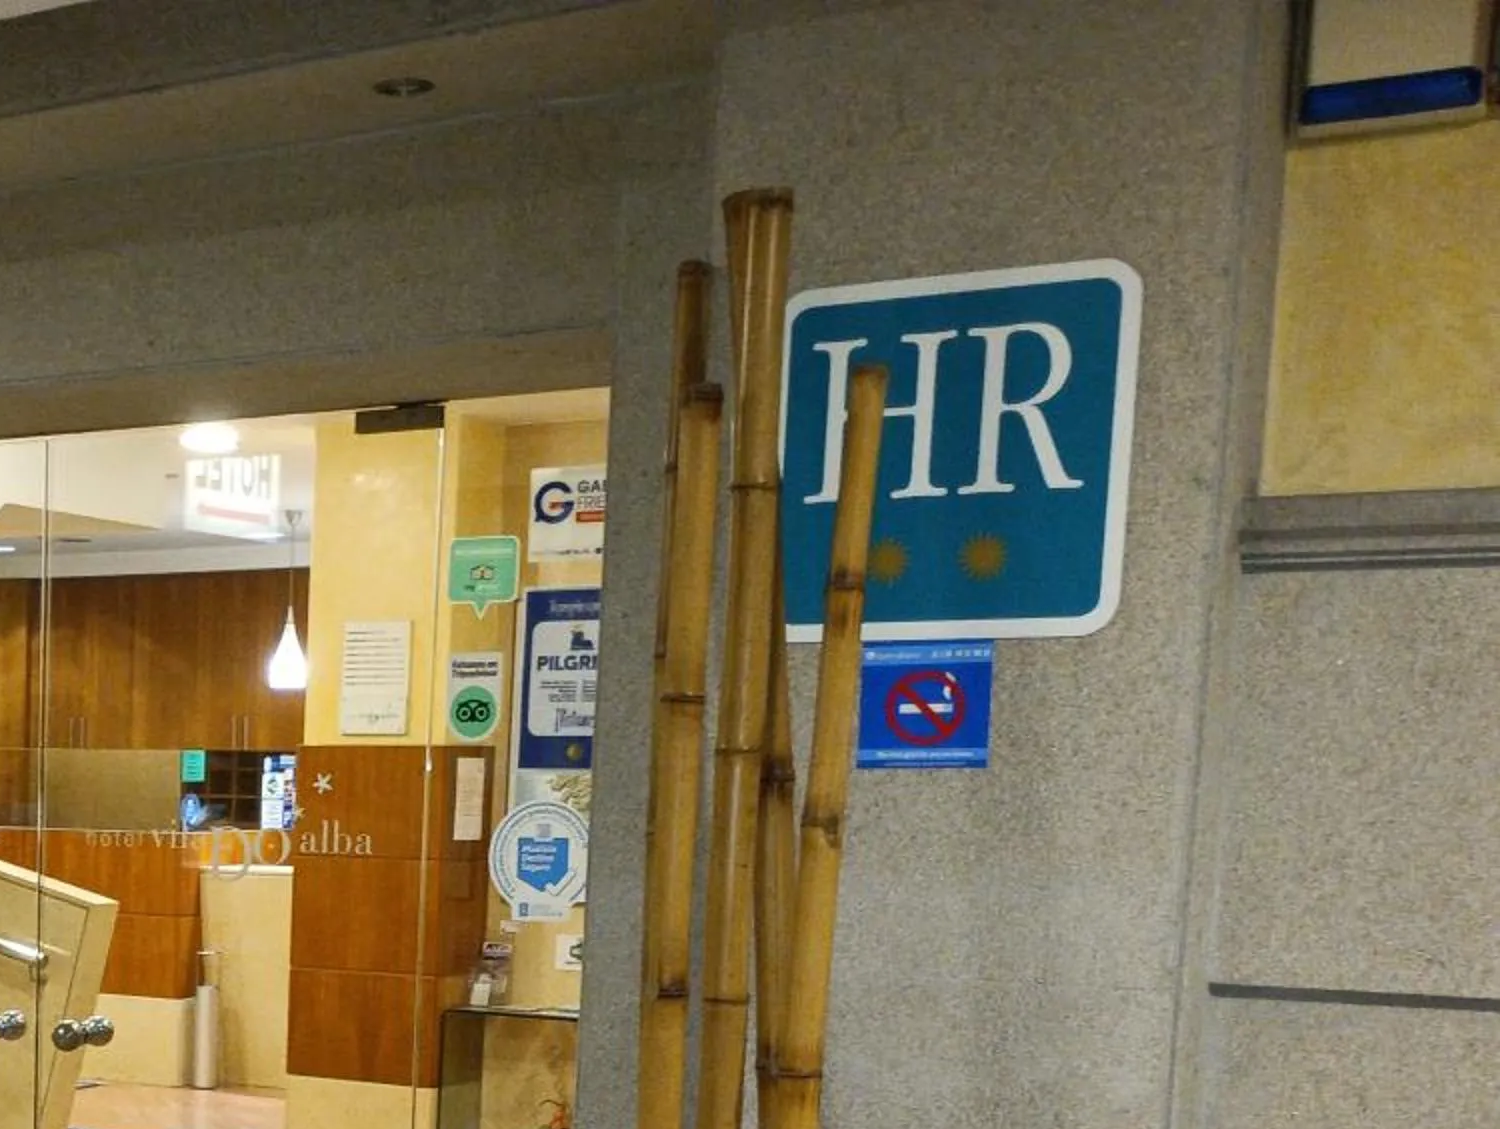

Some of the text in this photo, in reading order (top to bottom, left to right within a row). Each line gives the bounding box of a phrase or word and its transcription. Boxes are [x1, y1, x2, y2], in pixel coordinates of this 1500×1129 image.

[803, 321, 1085, 504] HR
[536, 654, 598, 672] PILGRI
[299, 819, 374, 857] alba
